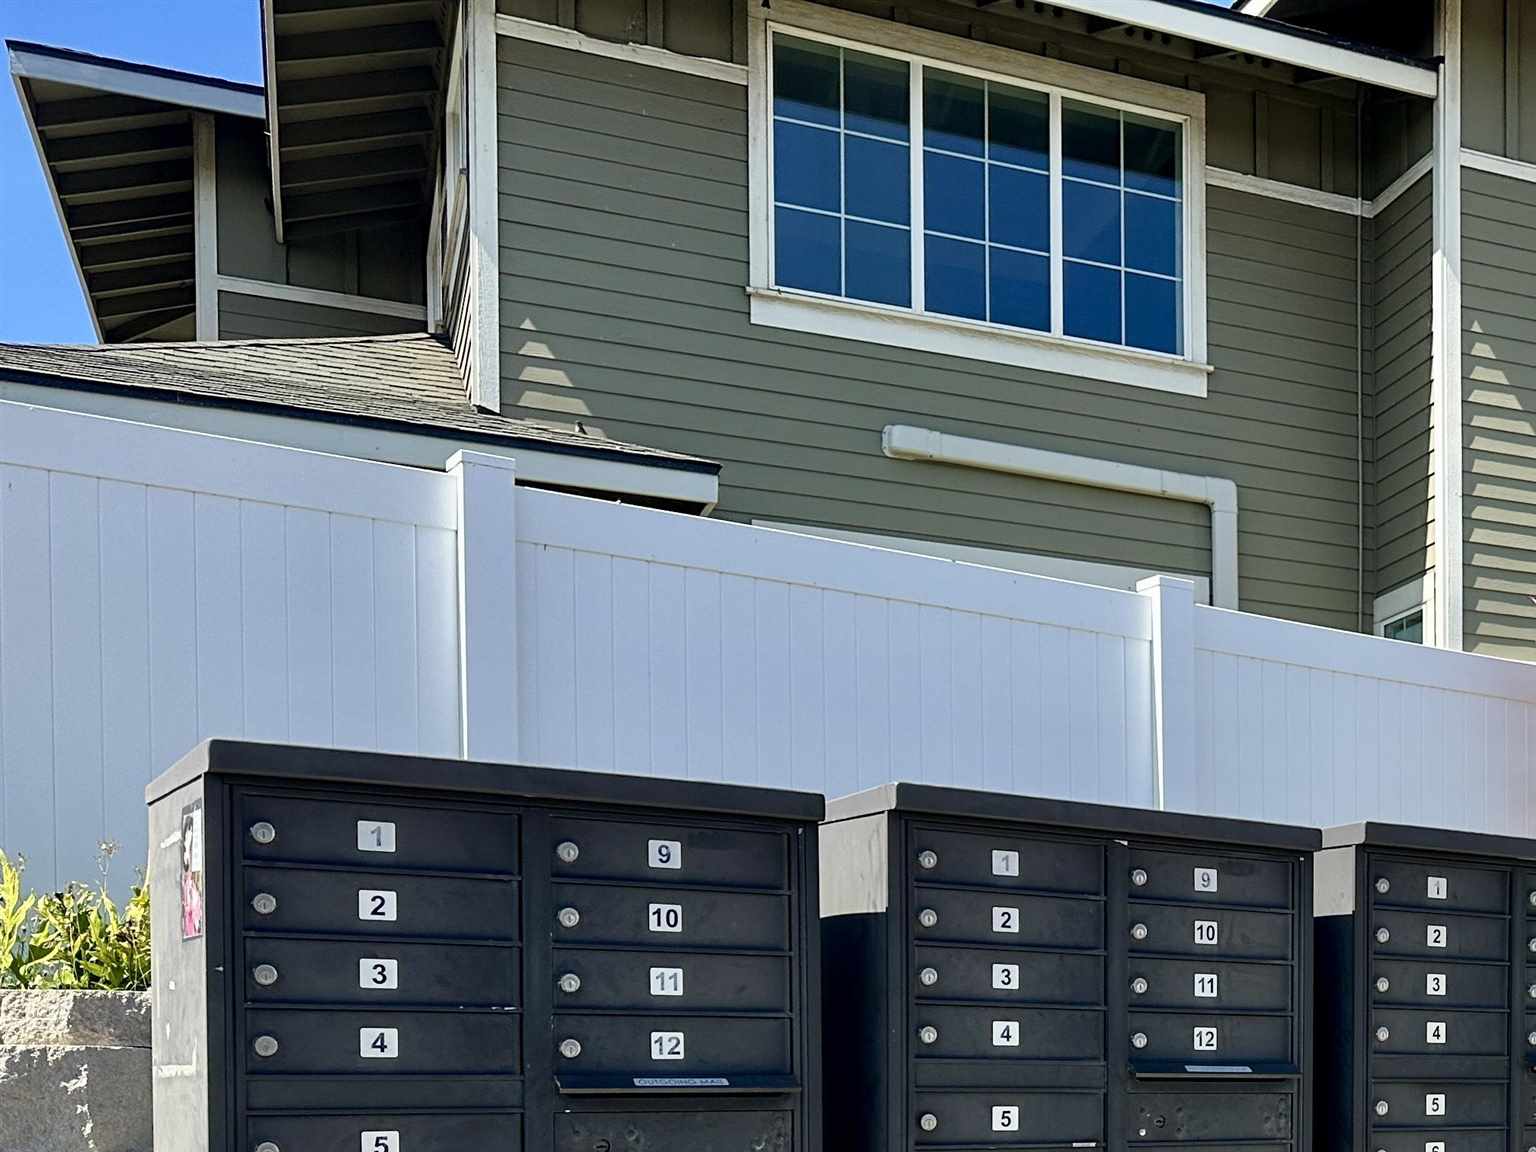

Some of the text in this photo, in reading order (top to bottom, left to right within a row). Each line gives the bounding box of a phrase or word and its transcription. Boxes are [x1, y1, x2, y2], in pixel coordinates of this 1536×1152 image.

[370, 825, 382, 847] 1
[657, 844, 671, 864] 9
[1001, 854, 1010, 873] 1
[1201, 872, 1211, 889] 9
[370, 895, 386, 917] 2
[651, 907, 679, 929] 10
[1000, 911, 1012, 929] 2
[1196, 924, 1216, 941] 10
[1432, 928, 1441, 944] 2
[371, 963, 387, 985] 3
[655, 971, 678, 992] 11
[1000, 968, 1012, 986] 3
[1197, 977, 1214, 994] 11
[1432, 976, 1441, 992] 3
[999, 1025, 1013, 1043] 4
[1195, 1030, 1215, 1047] 12
[1432, 1025, 1441, 1040] 4
[371, 1032, 388, 1053] 4
[653, 1036, 681, 1056] 12
[1431, 1097, 1440, 1113] 5
[1000, 1110, 1012, 1128] 5
